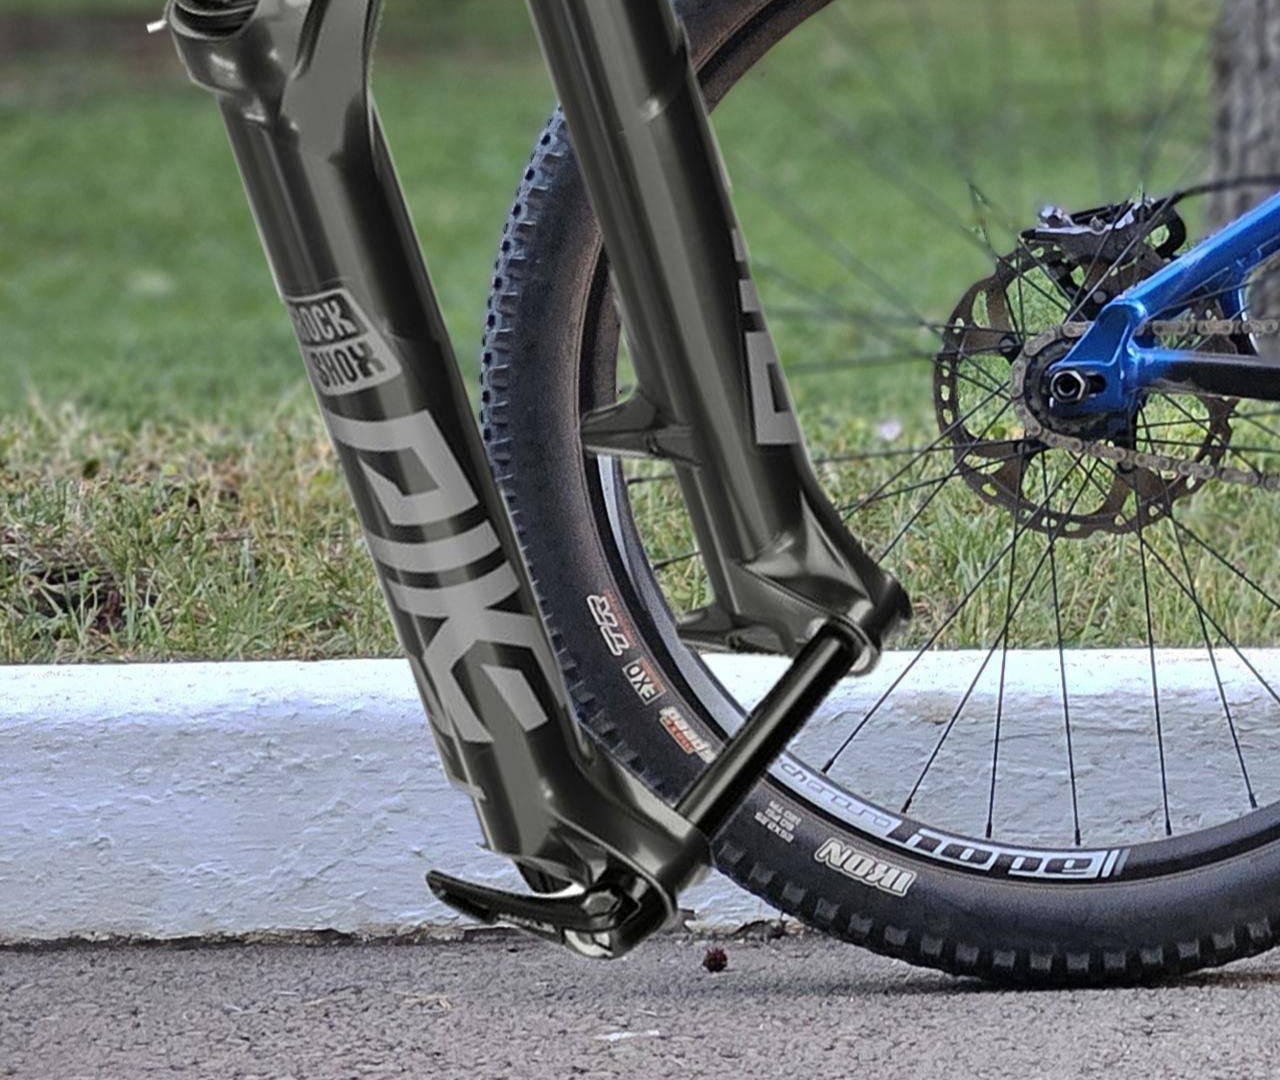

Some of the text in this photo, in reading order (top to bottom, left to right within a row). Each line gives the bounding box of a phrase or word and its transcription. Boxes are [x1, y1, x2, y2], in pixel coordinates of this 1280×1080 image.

[310, 339, 387, 389] SHOX
[586, 594, 630, 656] TR
[625, 664, 660, 702] EXO
[814, 838, 917, 897] IKON
